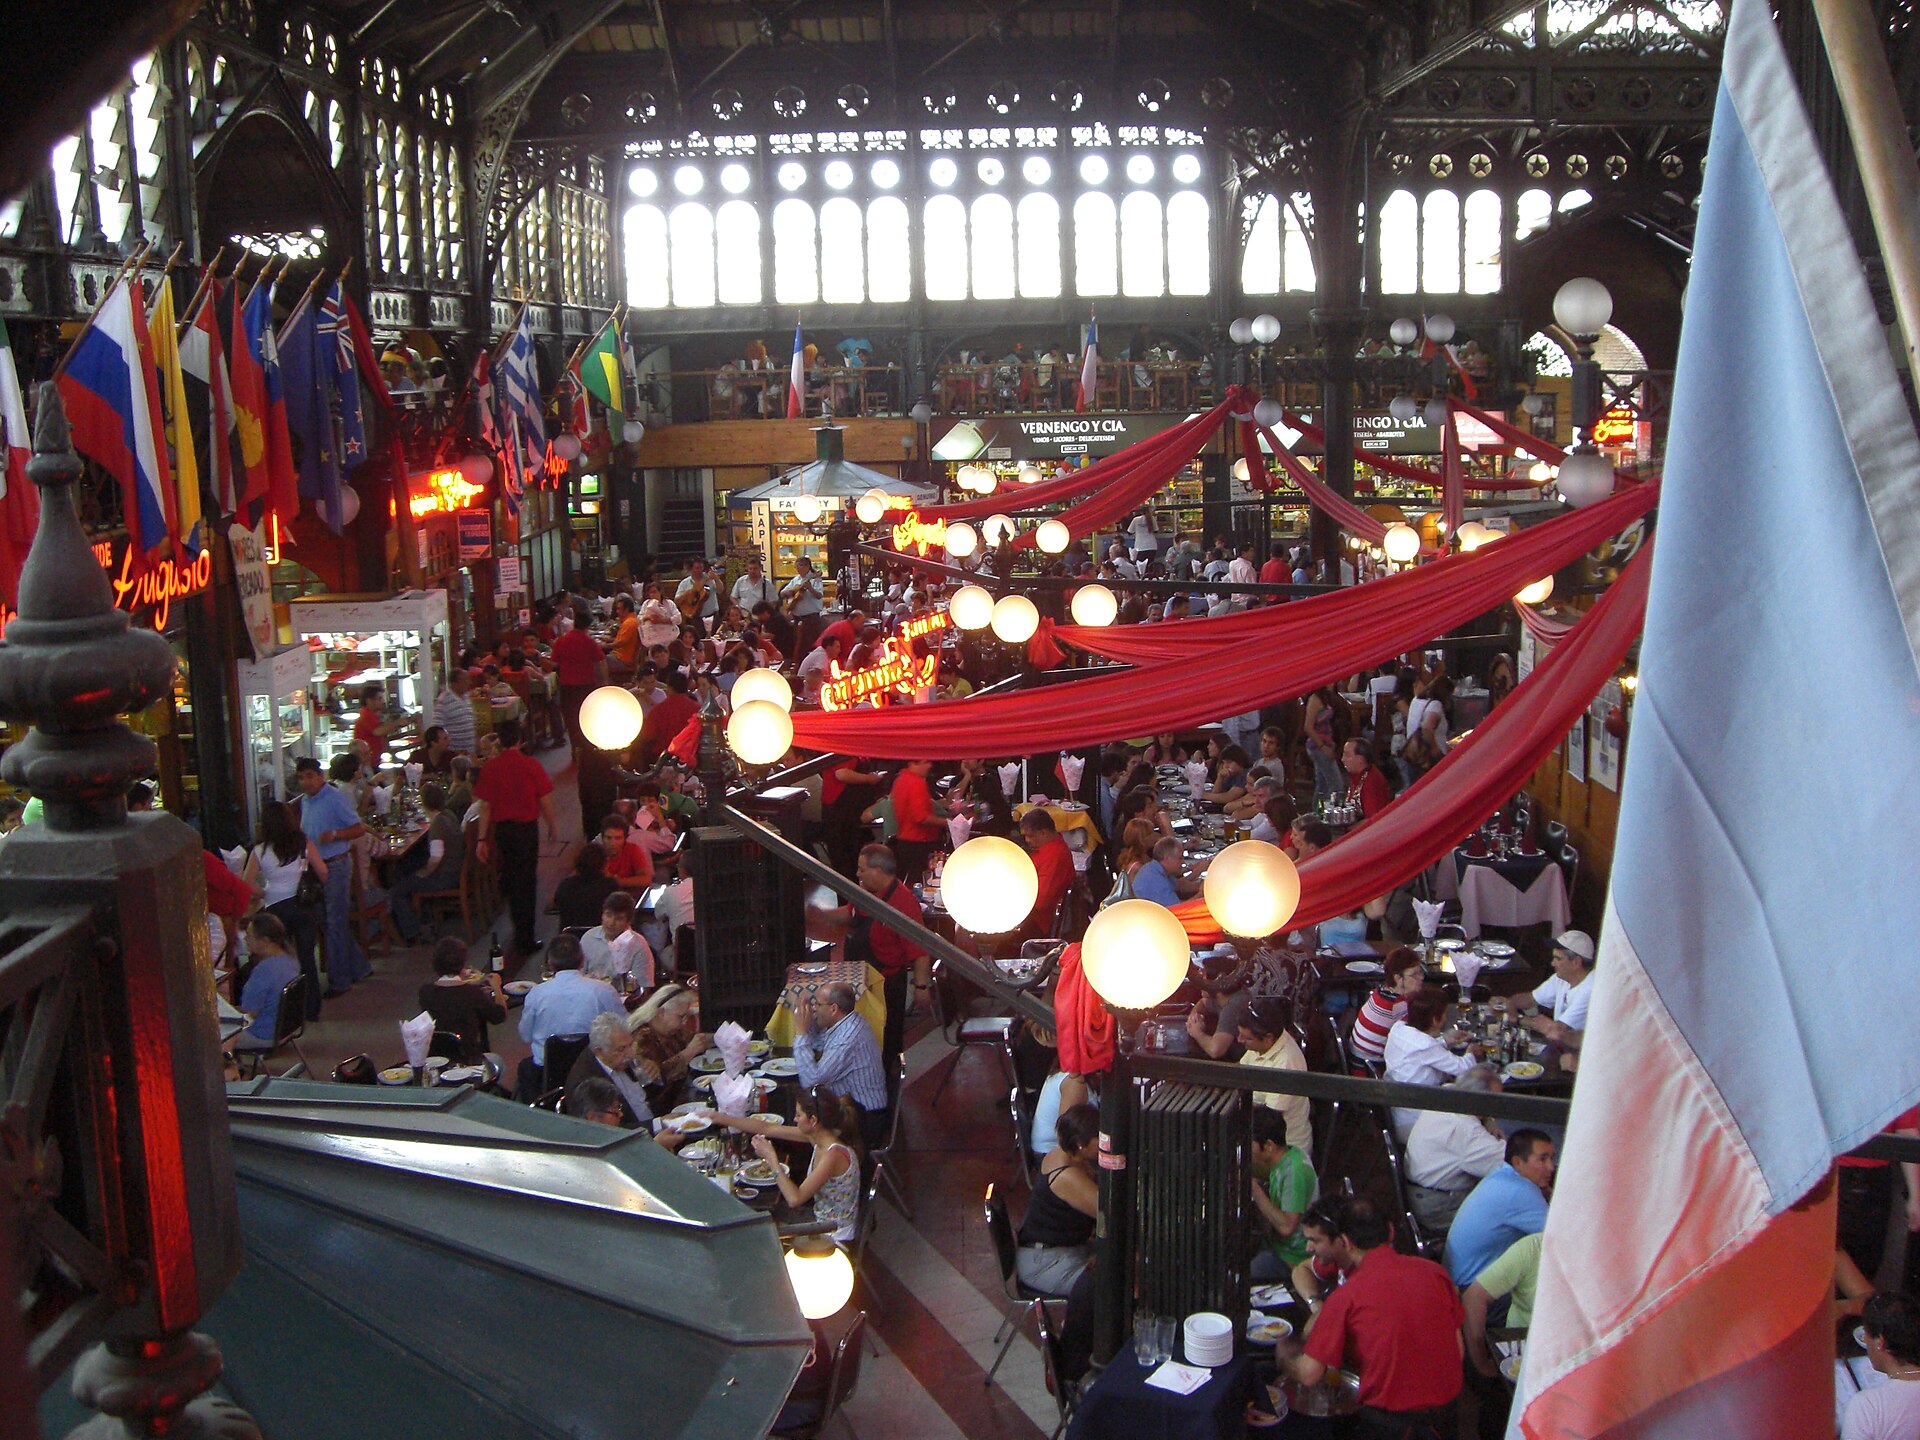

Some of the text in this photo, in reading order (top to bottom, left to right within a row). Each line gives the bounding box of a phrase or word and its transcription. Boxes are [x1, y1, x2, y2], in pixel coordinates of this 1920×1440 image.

[1020, 420, 1126, 434] VERNENGO Y CIA.
[1353, 417, 1391, 428] ENGO
